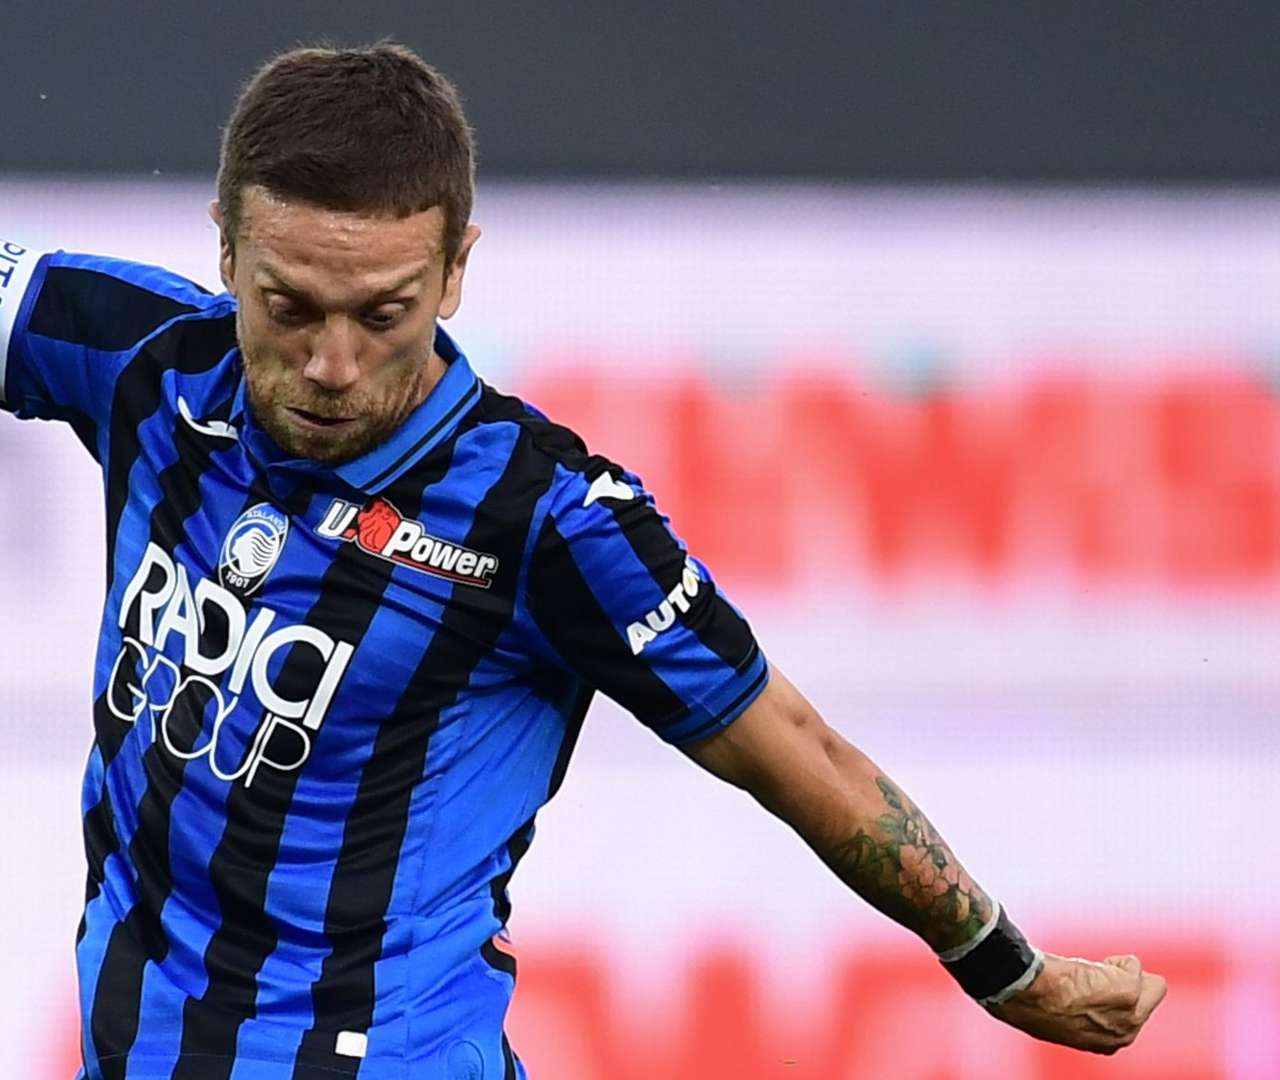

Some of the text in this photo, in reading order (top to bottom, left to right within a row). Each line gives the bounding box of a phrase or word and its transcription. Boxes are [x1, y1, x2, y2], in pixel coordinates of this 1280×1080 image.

[225, 571, 251, 589] 1907
[380, 519, 498, 579] Power
[118, 541, 355, 731] RADICI
[626, 553, 701, 656] AUTO
